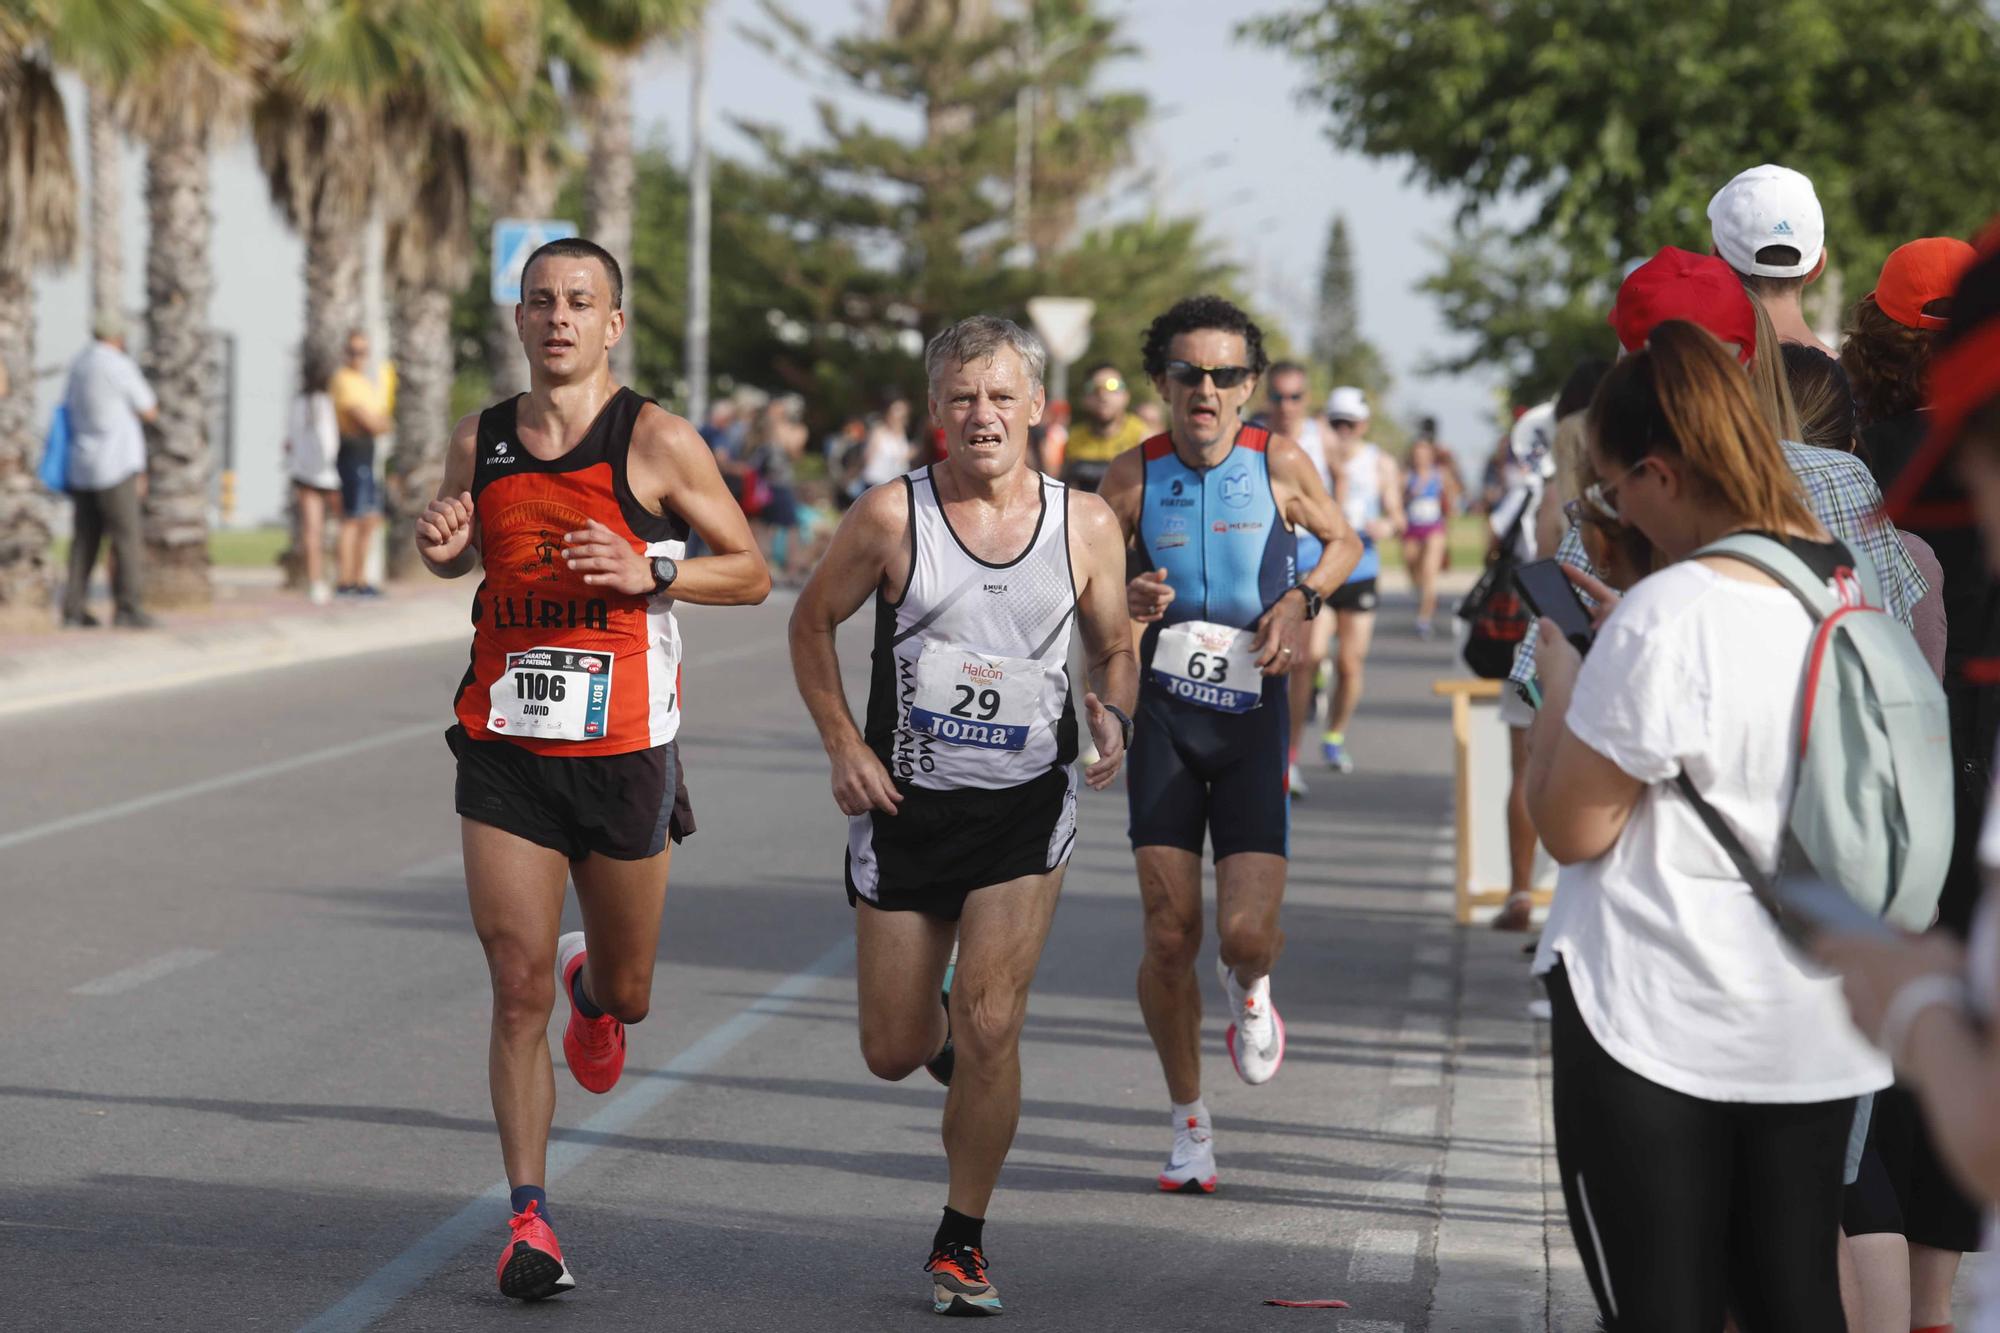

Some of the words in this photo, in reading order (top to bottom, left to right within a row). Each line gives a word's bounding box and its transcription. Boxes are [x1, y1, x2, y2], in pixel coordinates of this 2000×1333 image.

[486, 456, 515, 465] VIATOR
[494, 591, 608, 631] LLÍRIA
[525, 659, 552, 667] PATERNA
[1188, 652, 1229, 684] 63
[515, 672, 566, 702] 1106
[593, 684, 604, 704] BOX
[523, 704, 549, 716] DAVID
[950, 685, 1001, 721] 29
